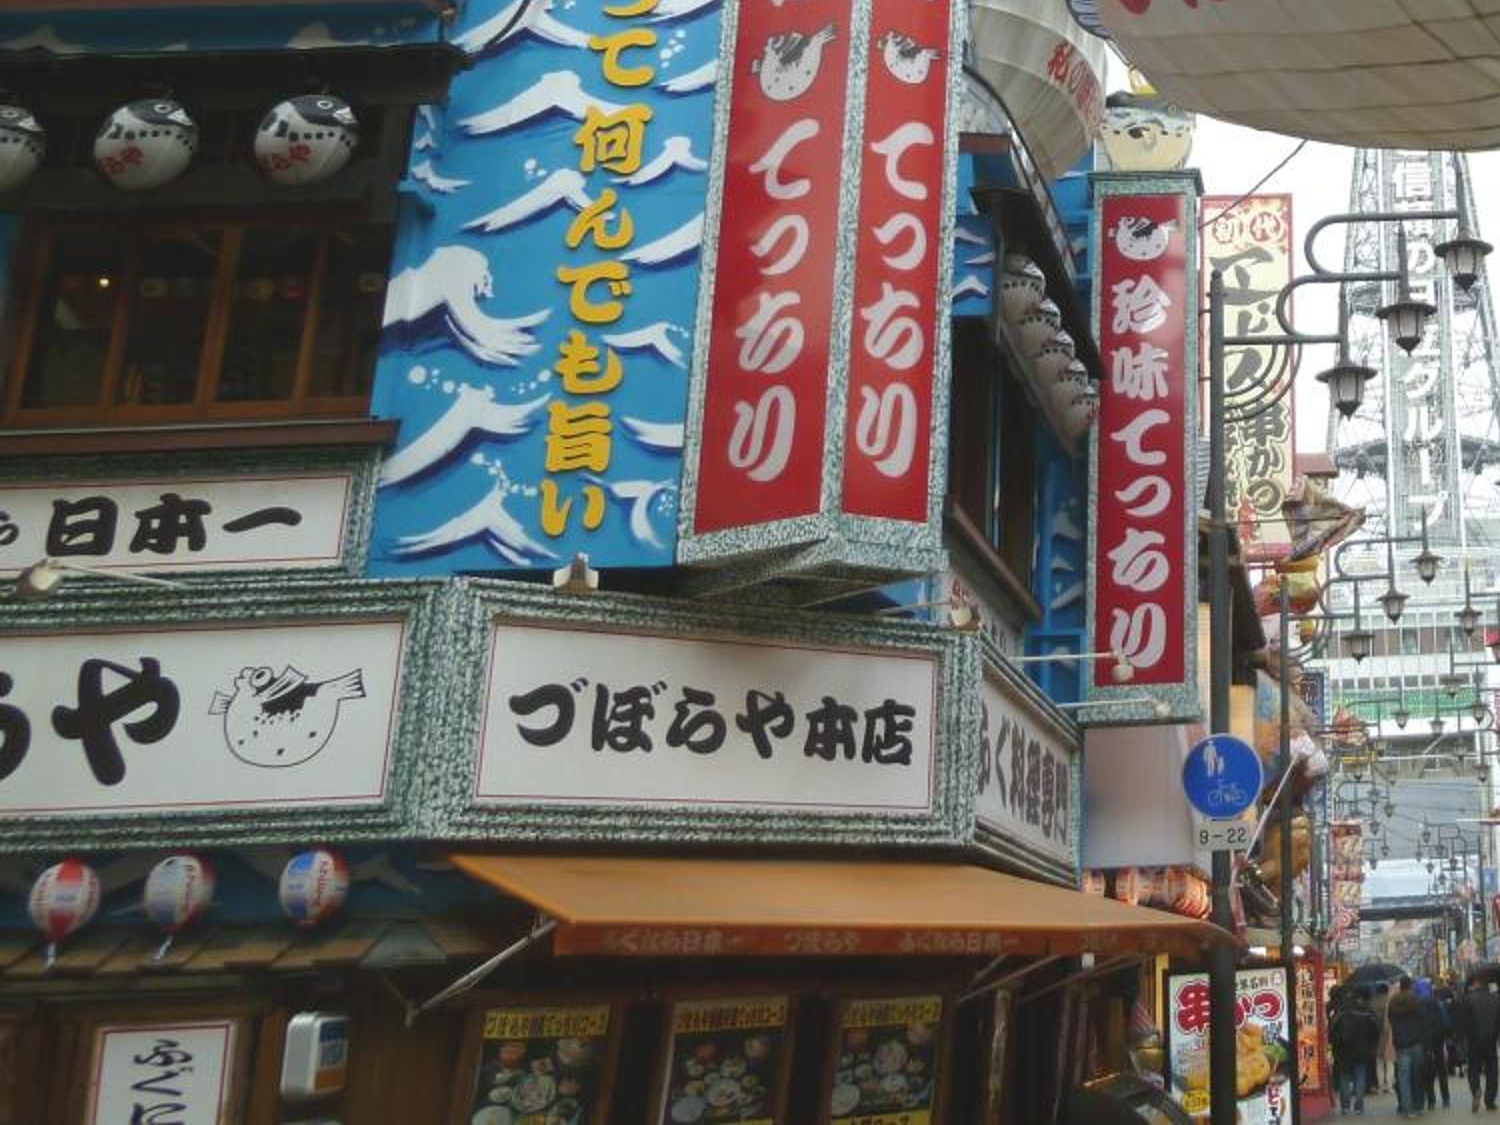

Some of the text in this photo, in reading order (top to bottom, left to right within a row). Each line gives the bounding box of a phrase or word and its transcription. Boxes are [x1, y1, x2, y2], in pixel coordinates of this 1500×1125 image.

[0, 657, 181, 786] や
[508, 677, 916, 766] づぼらや本店
[1200, 827, 1248, 845] 9-22
